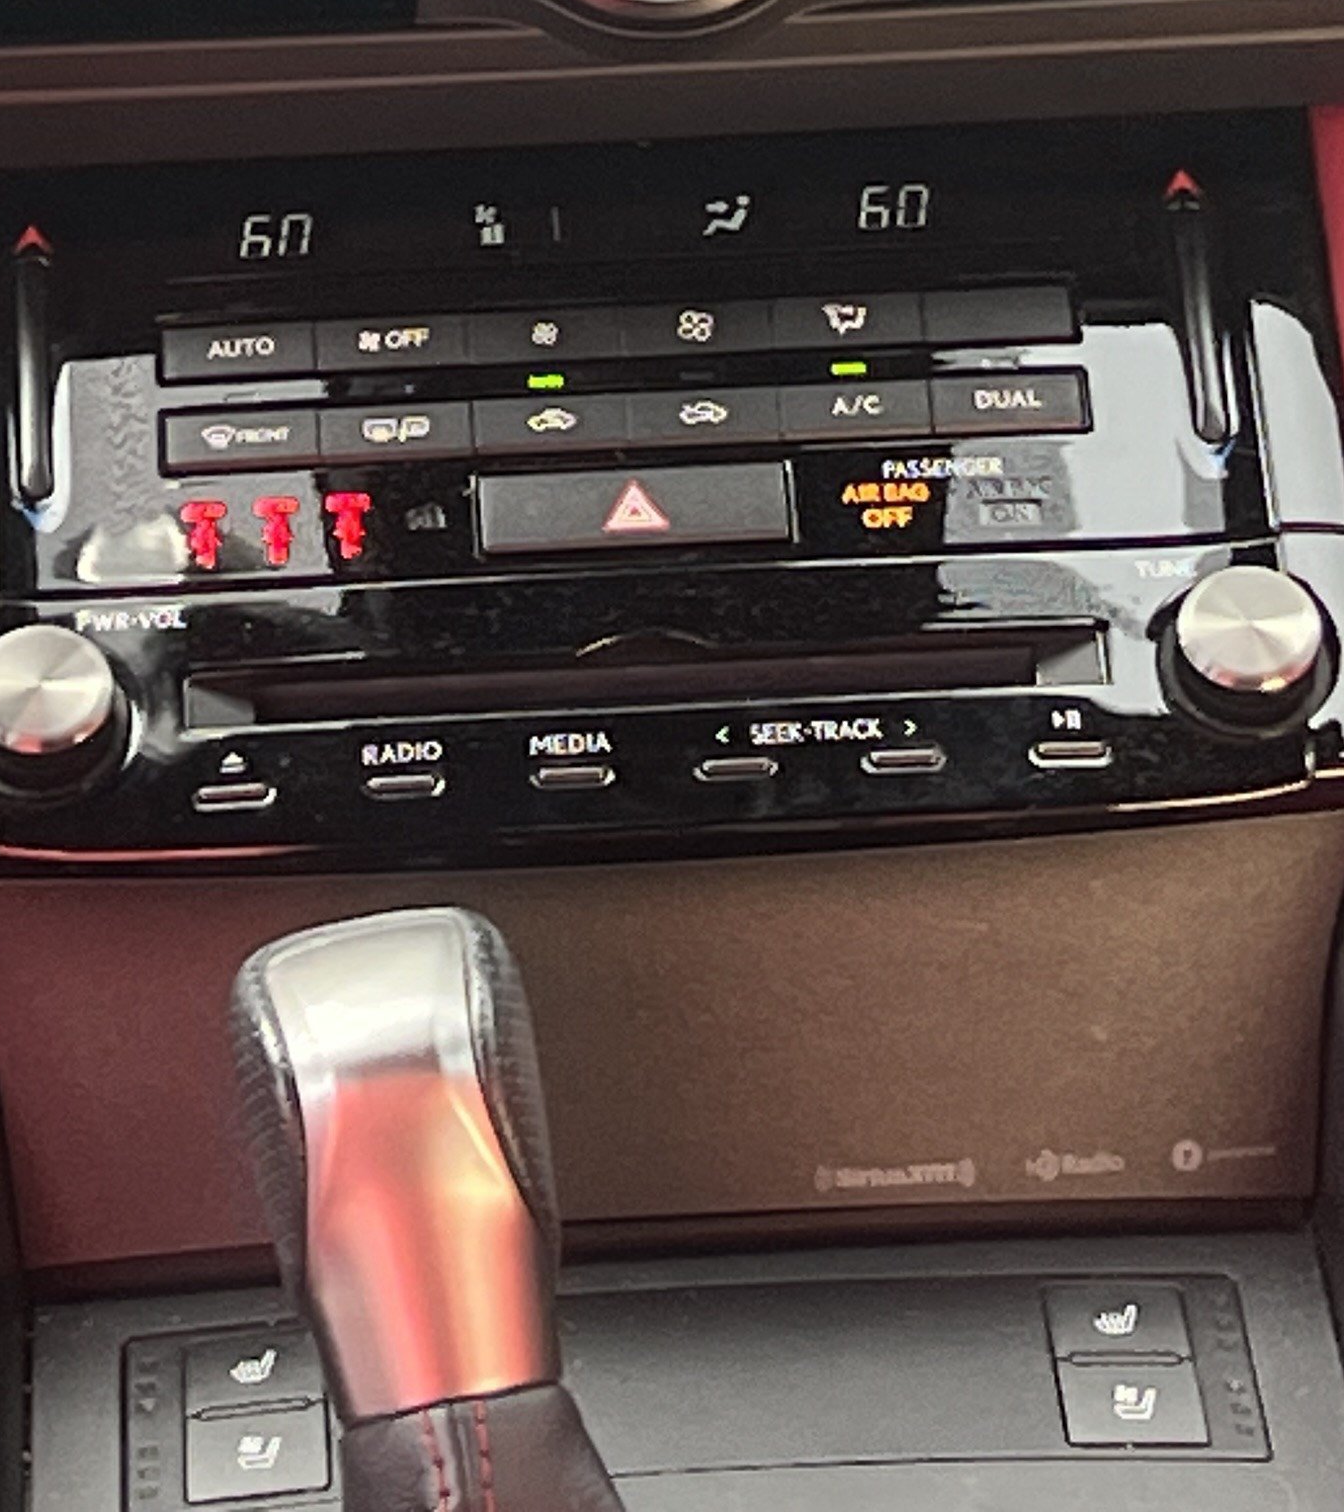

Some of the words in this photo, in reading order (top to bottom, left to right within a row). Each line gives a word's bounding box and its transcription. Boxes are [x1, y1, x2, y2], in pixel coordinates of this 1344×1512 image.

[858, 183, 930, 230] 60
[207, 336, 275, 360] AUTO
[384, 327, 430, 350] OFF
[831, 394, 885, 417] A/C
[974, 389, 1043, 410] DUAL
[882, 456, 1004, 479] PASSENGER
[861, 506, 914, 528] OFF
[361, 740, 443, 766] RADIO
[528, 731, 613, 756] MEDIA
